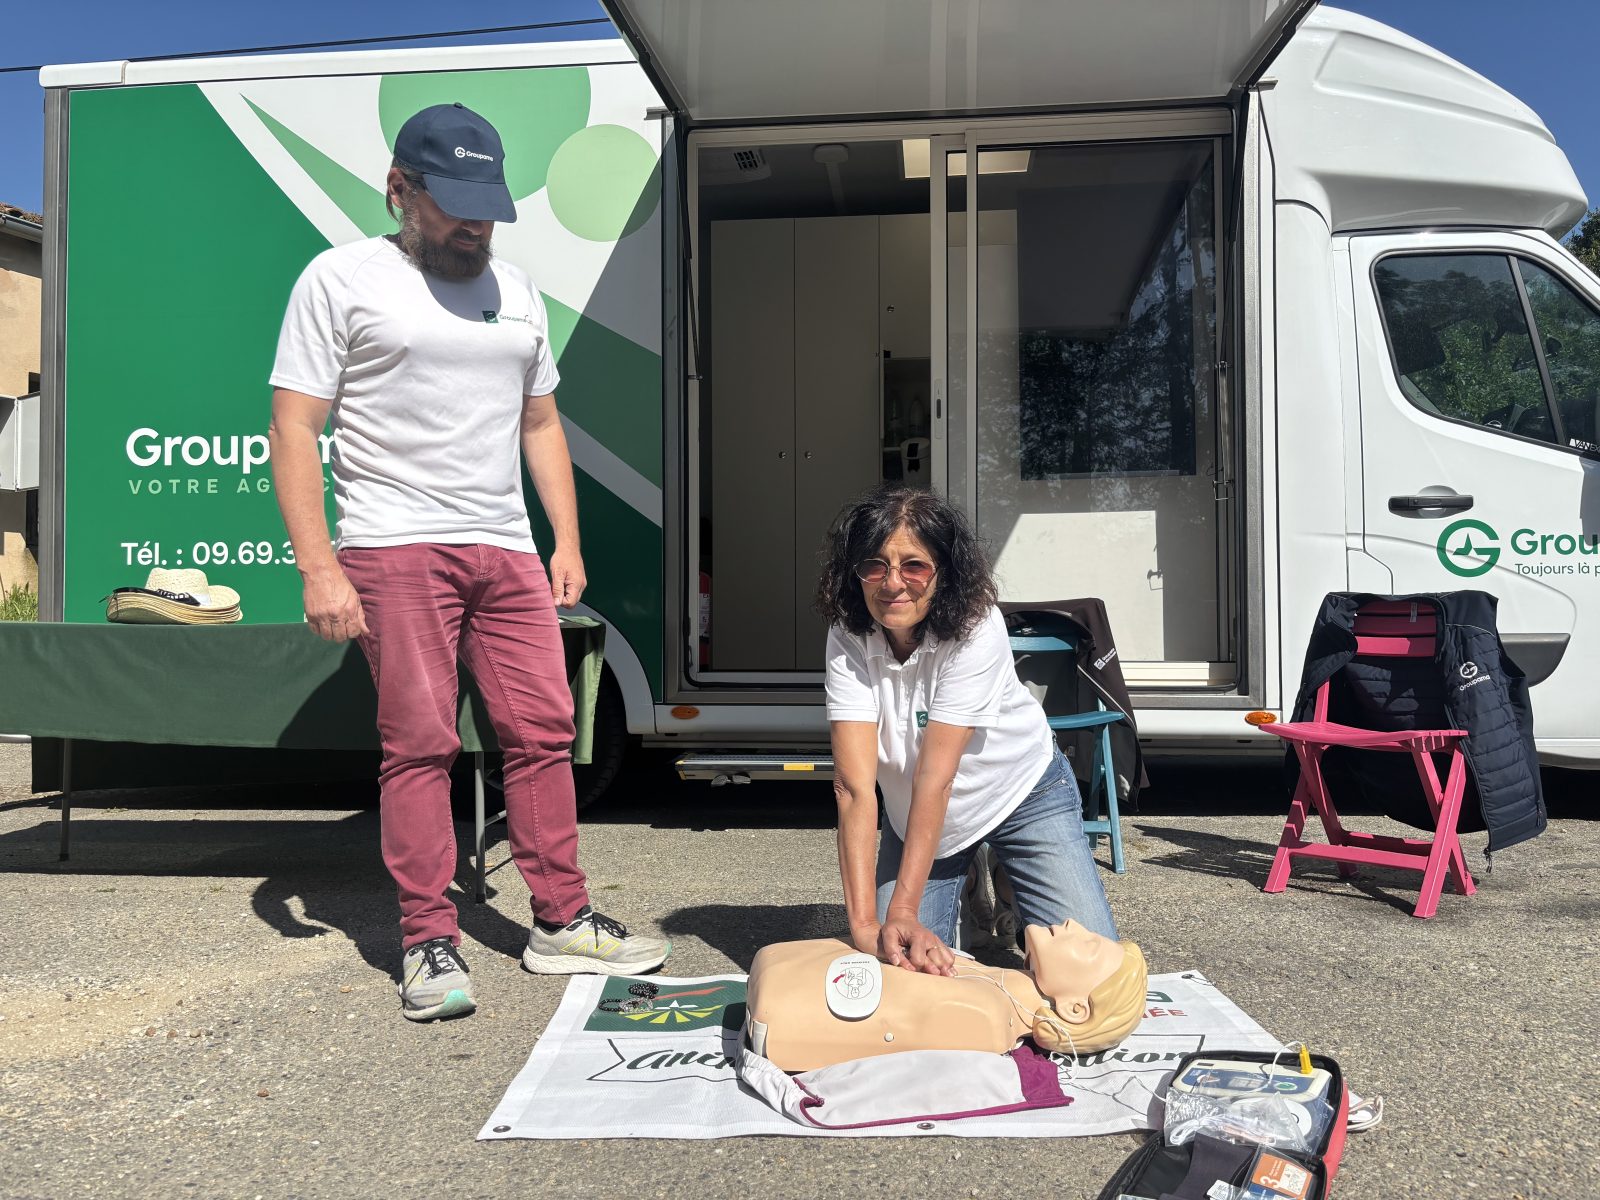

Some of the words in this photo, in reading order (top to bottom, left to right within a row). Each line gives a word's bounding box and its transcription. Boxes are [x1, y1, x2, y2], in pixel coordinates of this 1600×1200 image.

[128, 478, 219, 495] VOTRE
[1510, 528, 1599, 556] Grou
[120, 541, 167, 566] Tél.
[192, 541, 297, 566] 09.69.3
[1514, 562, 1574, 577] Toujours
[1578, 562, 1590, 574] là
